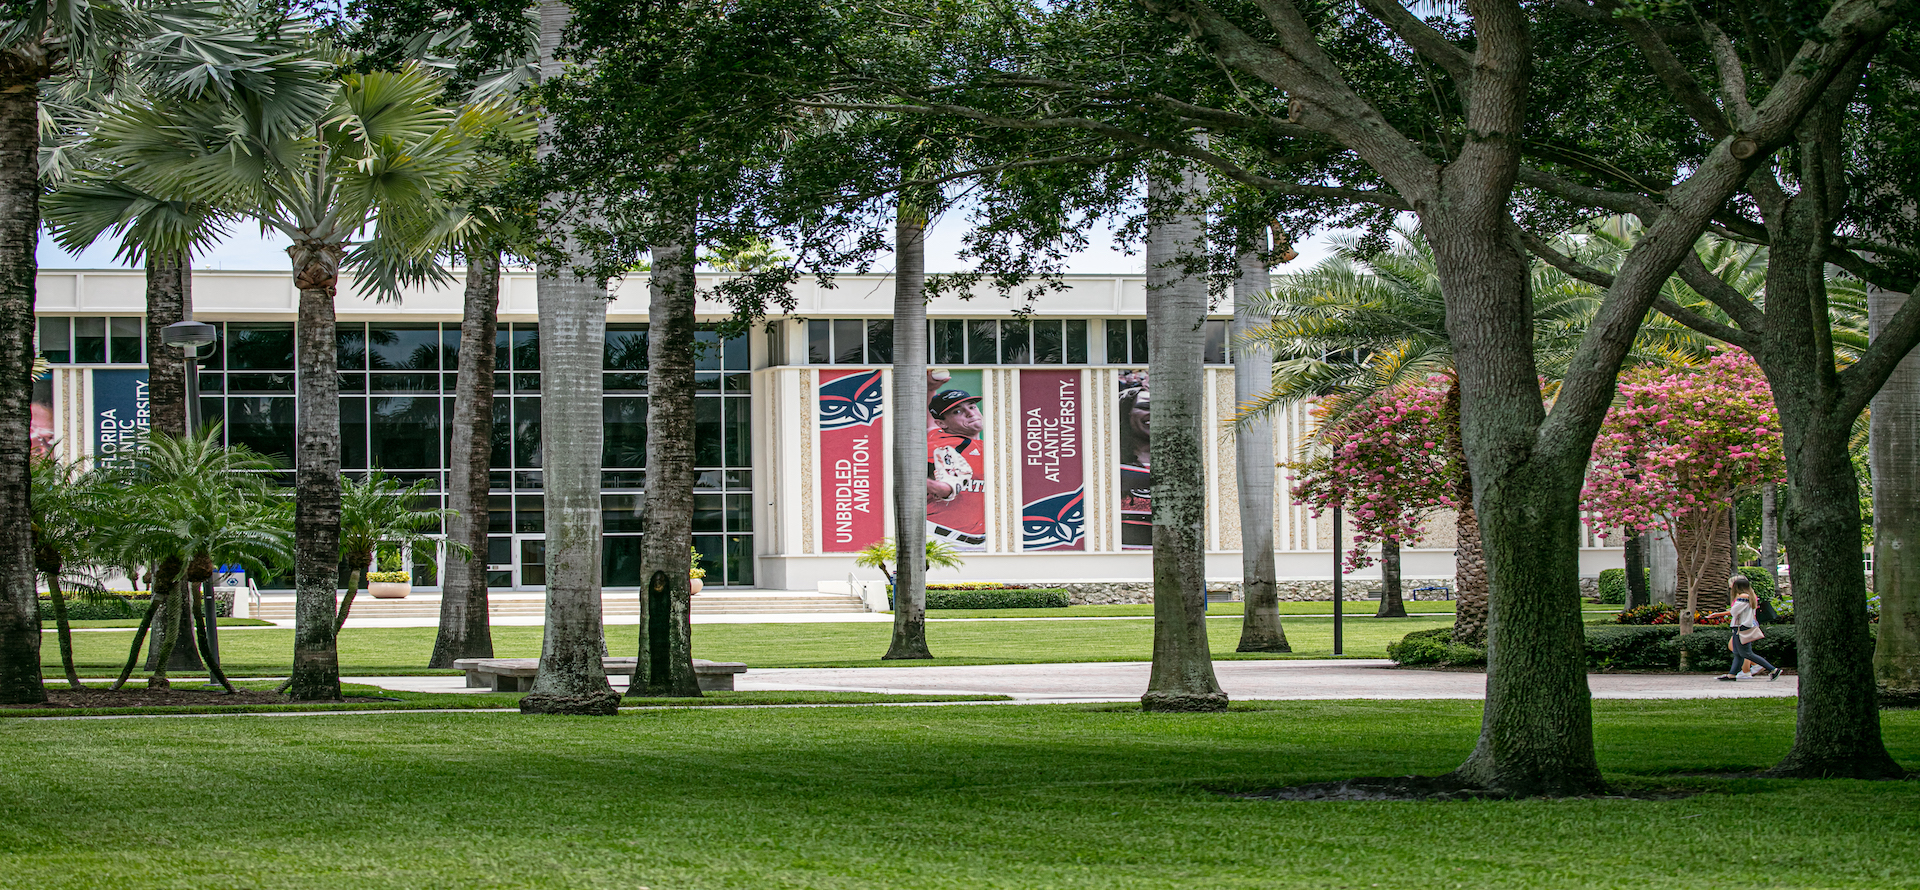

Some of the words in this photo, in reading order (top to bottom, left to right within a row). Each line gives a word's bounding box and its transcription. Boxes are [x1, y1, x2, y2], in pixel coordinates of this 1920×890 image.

[100, 408, 117, 470] FLORIDA
[1027, 407, 1042, 466] FLORIDA
[1043, 417, 1060, 483] ATLANTIC
[835, 459, 853, 543] UNBRIDLED
